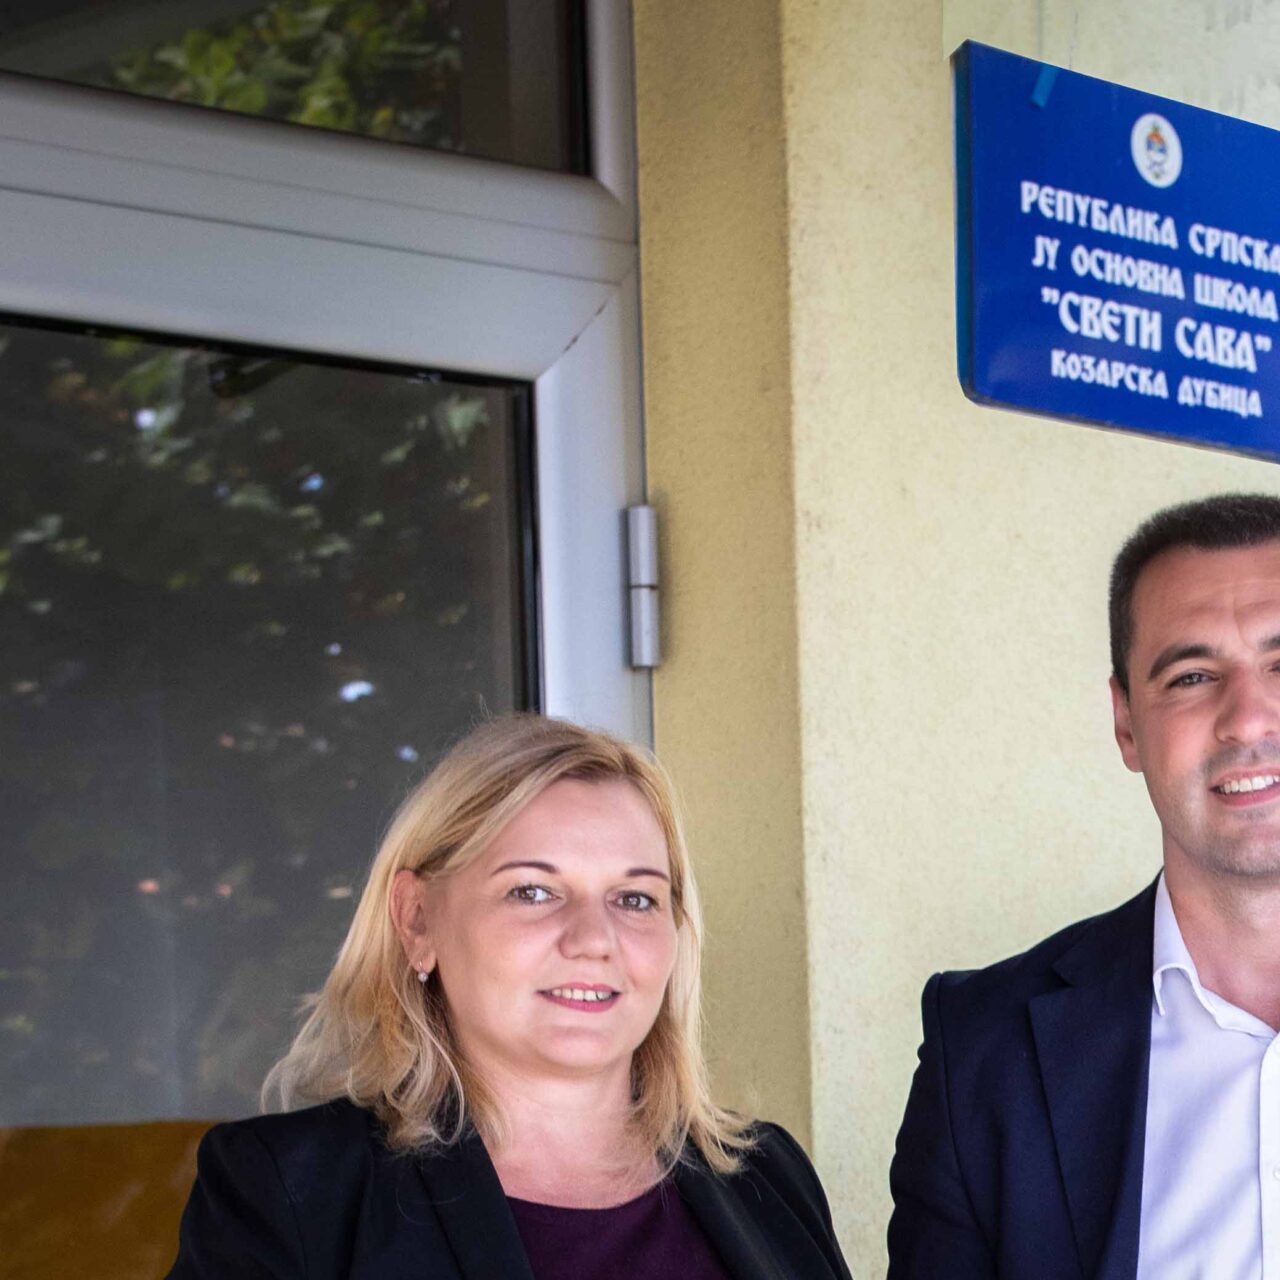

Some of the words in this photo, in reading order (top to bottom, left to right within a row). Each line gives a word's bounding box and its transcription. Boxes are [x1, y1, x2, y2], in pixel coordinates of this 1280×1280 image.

[1020, 181, 1178, 249] РЕПУБЛИКА
[1031, 235, 1062, 271] ЈУ
[1071, 244, 1185, 300] ОСНОВНА
[1194, 274, 1279, 323] ШКОЛА
[1050, 349, 1169, 399] КОЗАРСКА
[1178, 375, 1263, 418] ДУБИЦА
